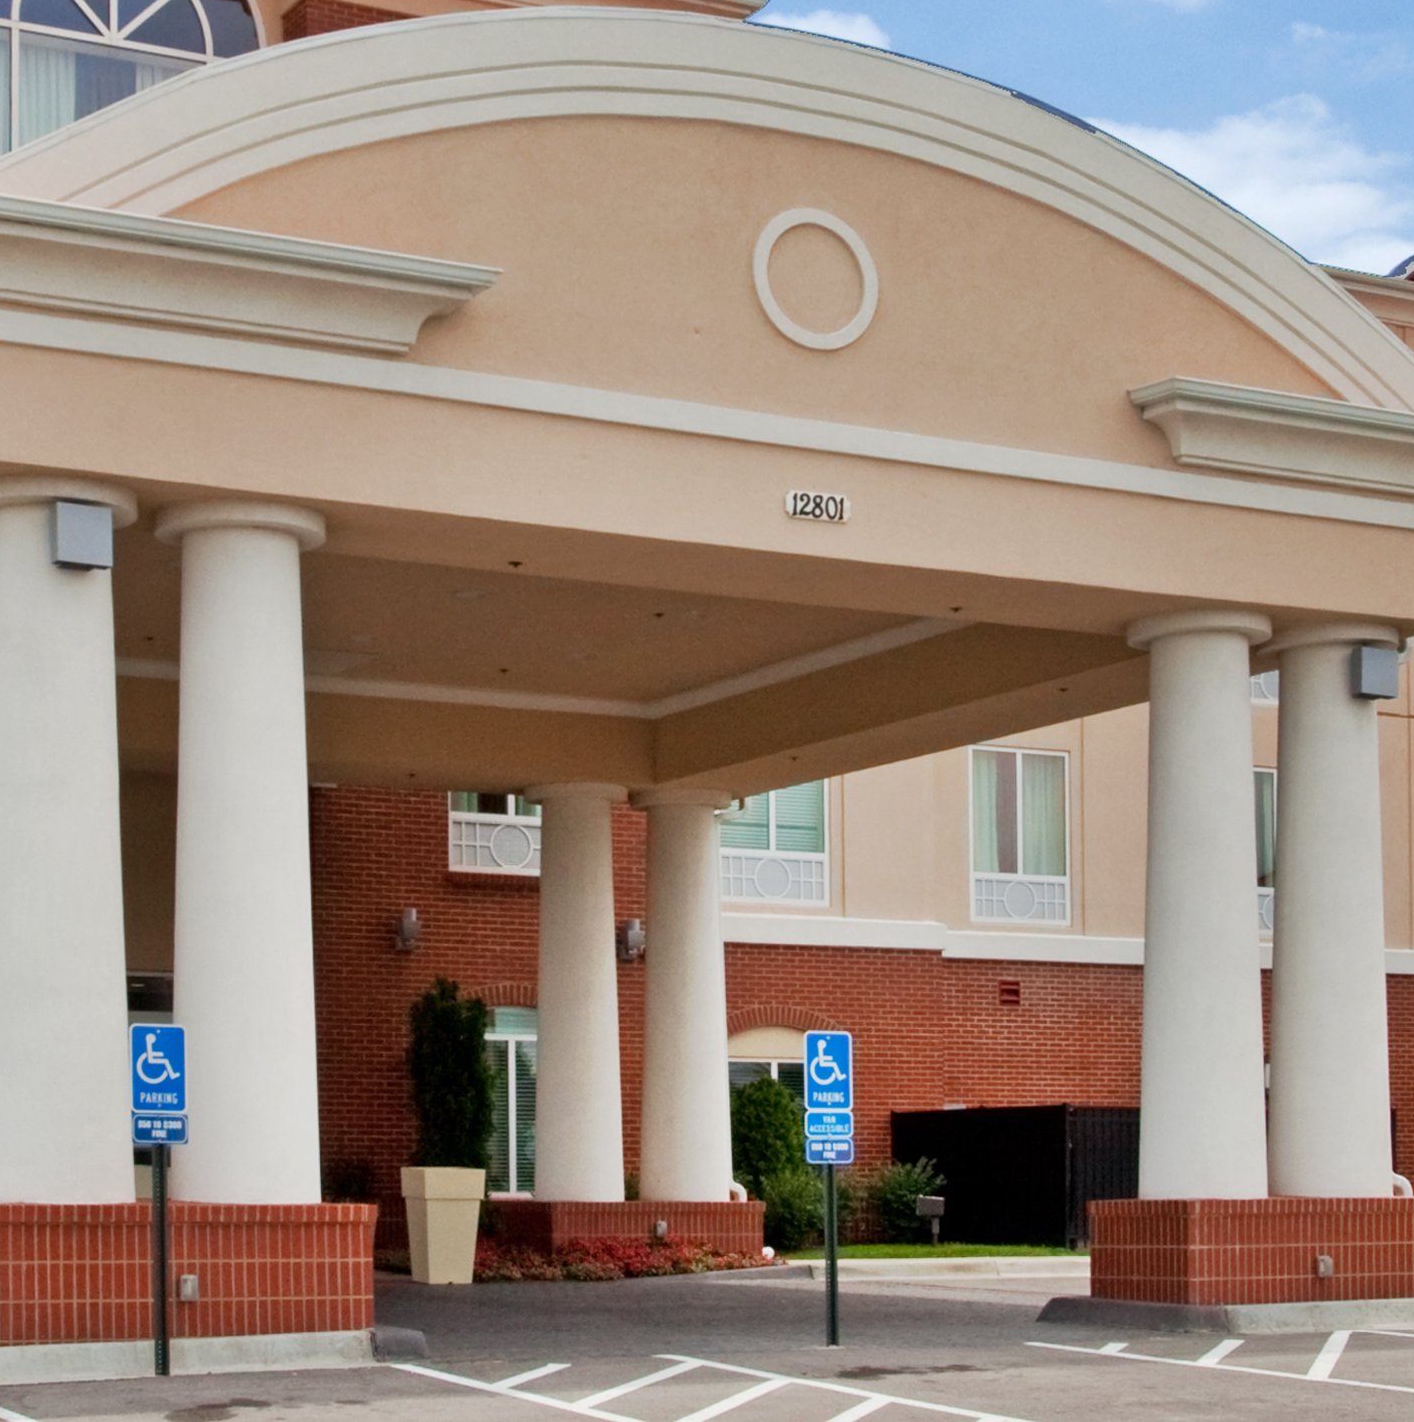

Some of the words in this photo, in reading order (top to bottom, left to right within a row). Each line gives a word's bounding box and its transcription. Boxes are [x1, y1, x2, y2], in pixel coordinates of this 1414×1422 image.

[792, 492, 845, 521] 12801
[139, 1091, 179, 1105] PARKING
[812, 1091, 845, 1103] PARKING
[809, 1124, 850, 1134] ACCESSIBLE
